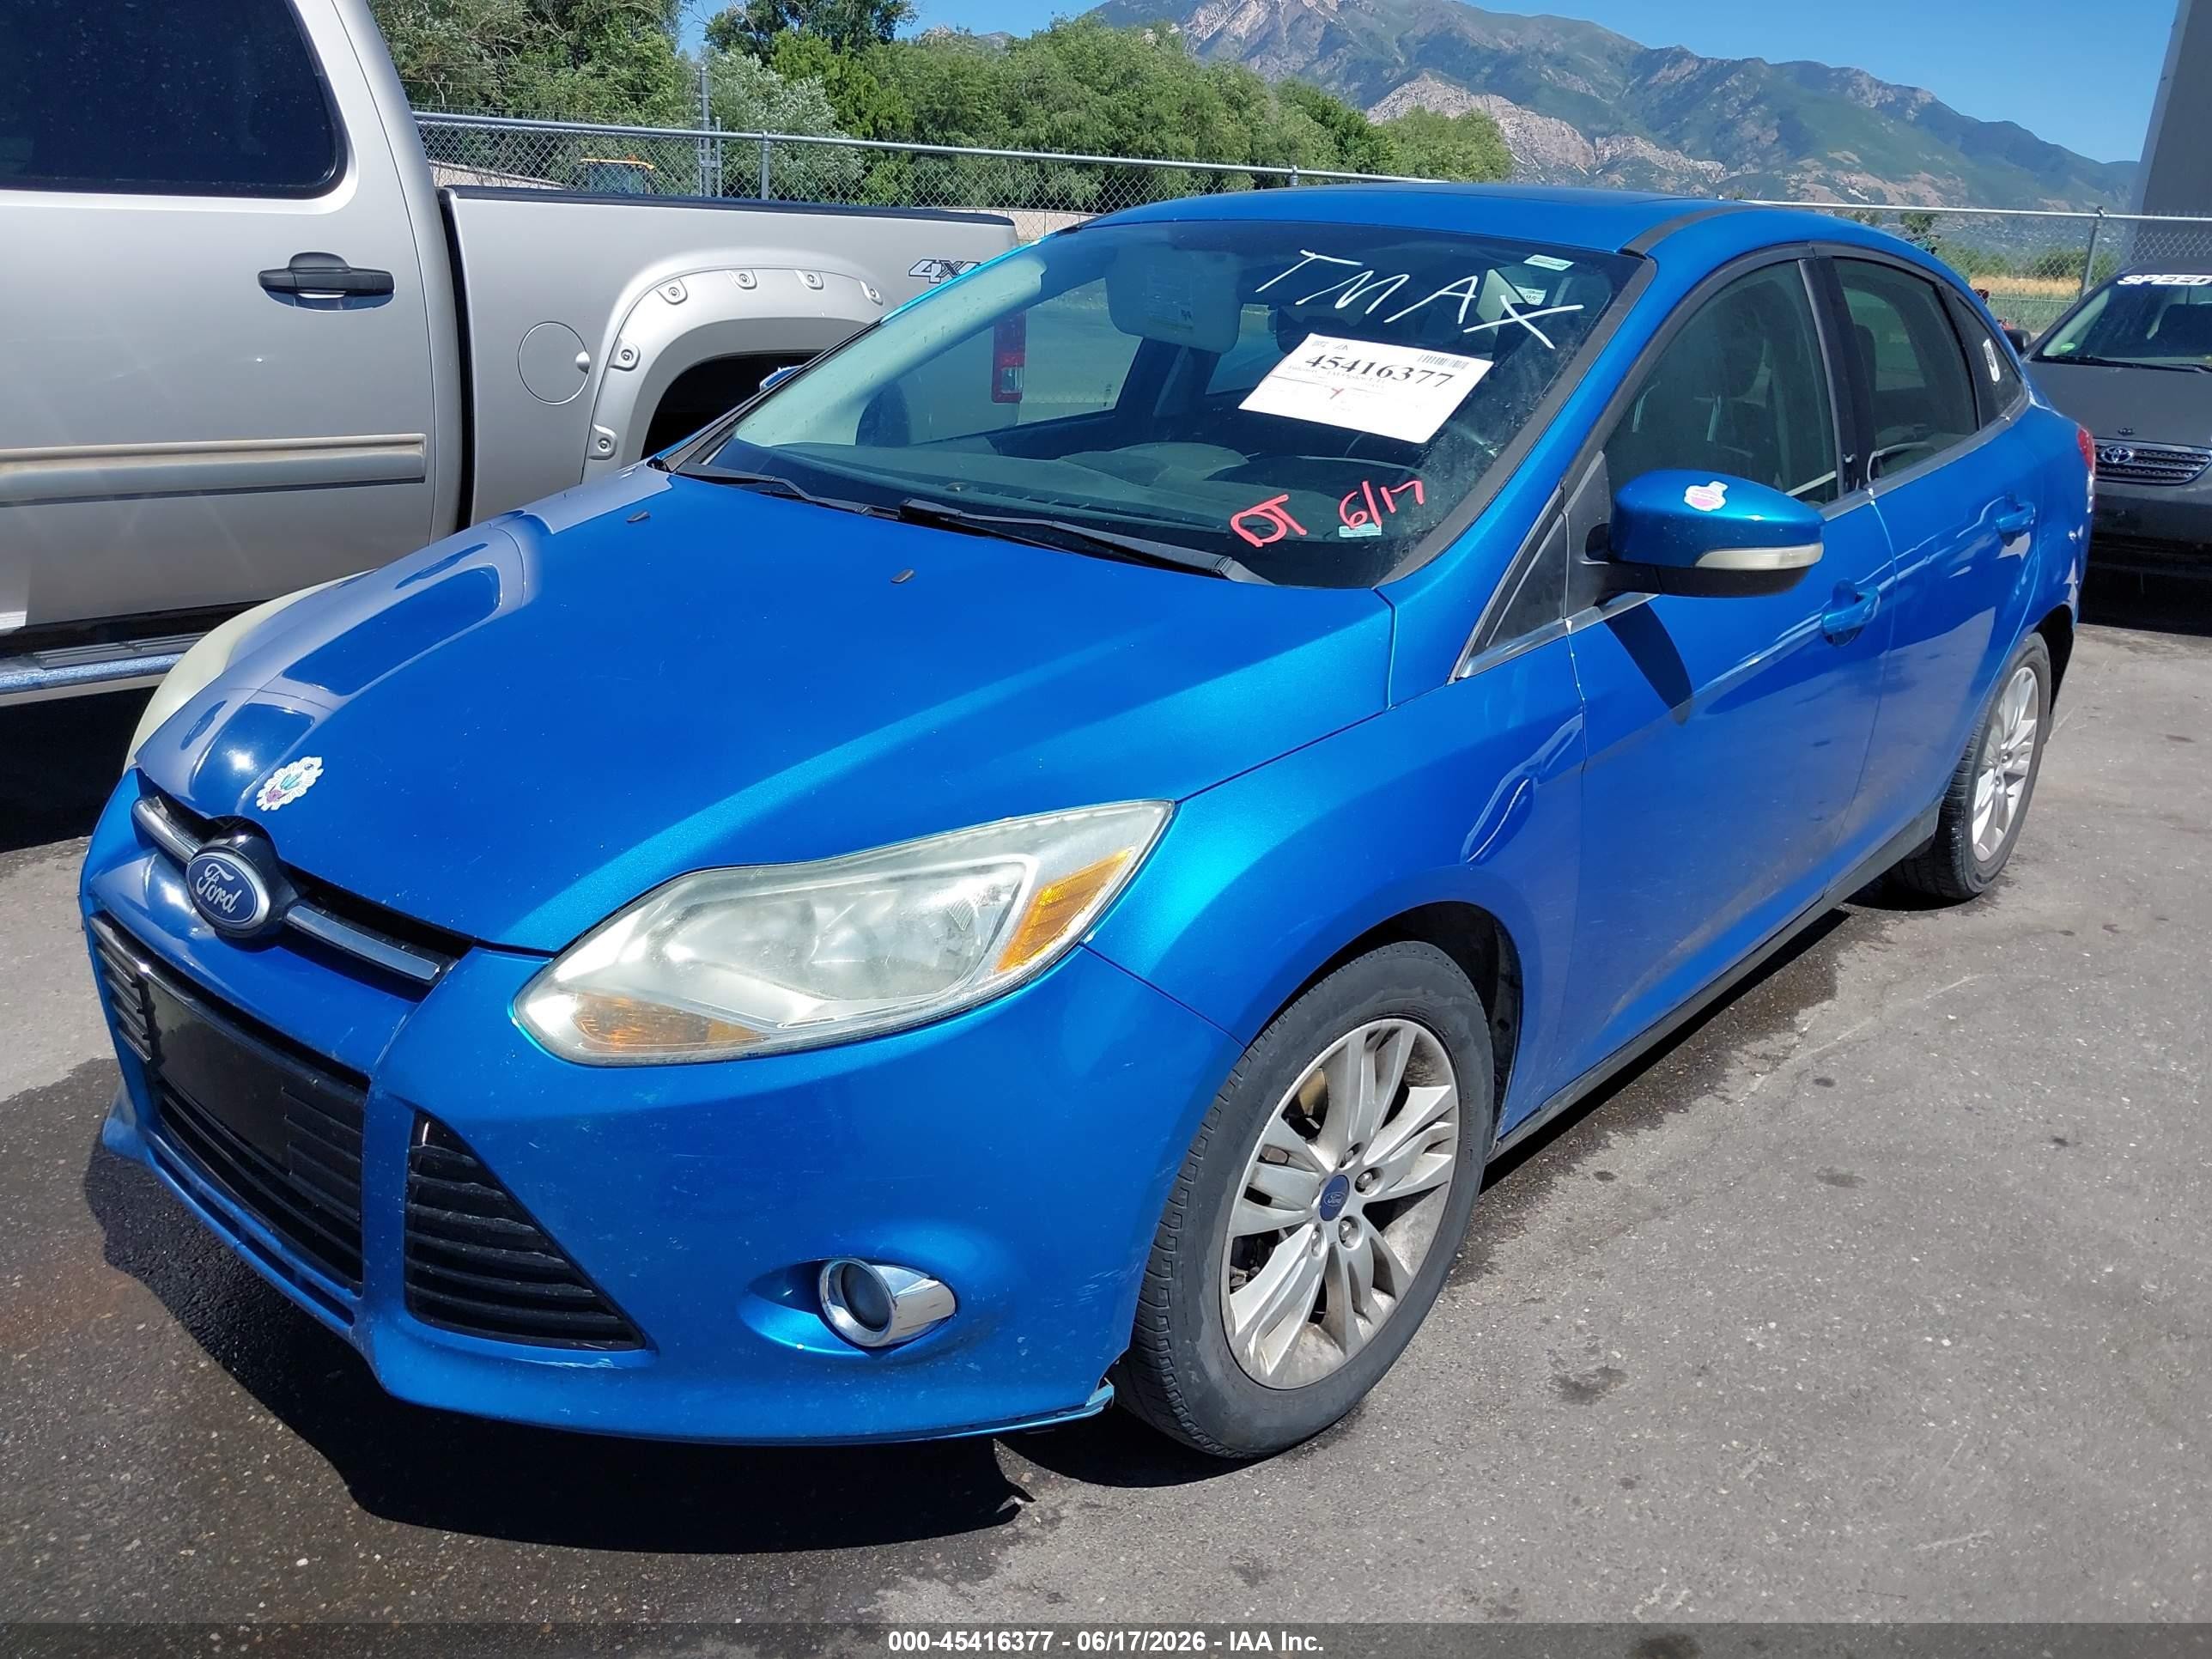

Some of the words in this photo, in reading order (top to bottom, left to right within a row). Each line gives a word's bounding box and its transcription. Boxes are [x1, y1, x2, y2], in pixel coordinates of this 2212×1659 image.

[1255, 248, 1585, 350] TMAX
[1304, 353, 1455, 388] 45416377
[1339, 480, 1425, 530] 6/17
[196, 862, 244, 914] Ford
